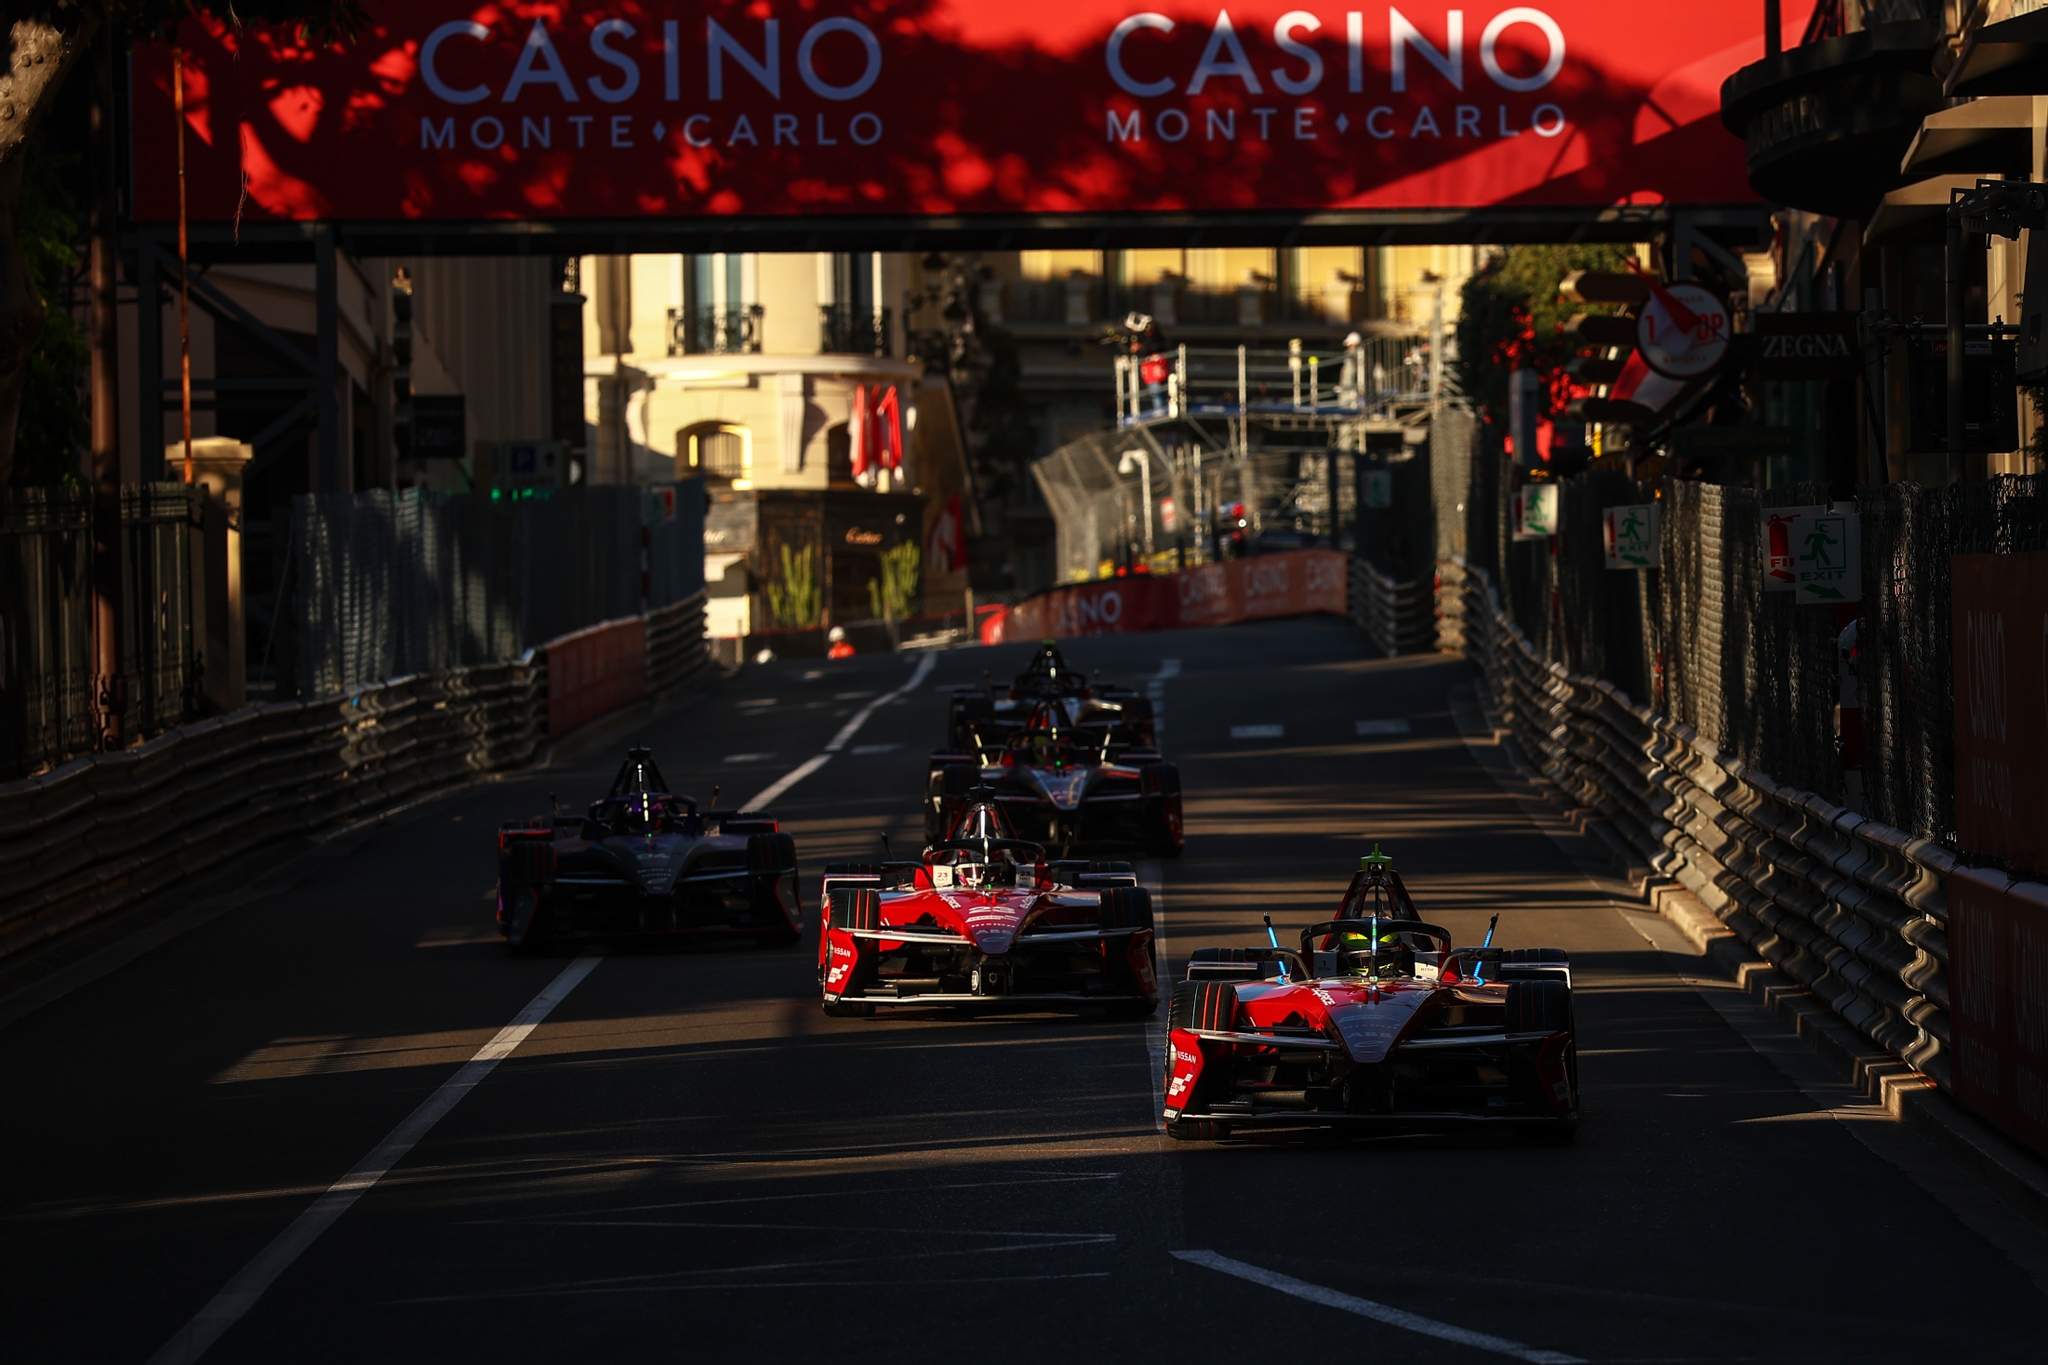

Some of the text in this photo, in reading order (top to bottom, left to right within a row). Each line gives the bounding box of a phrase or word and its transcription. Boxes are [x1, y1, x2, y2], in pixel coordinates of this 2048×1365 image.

[419, 17, 883, 105] CASINO
[1105, 7, 1566, 98] CASINO
[420, 112, 883, 149] MONTE CARLO
[1106, 103, 1566, 142] MONTE CARLO
[1760, 333, 1851, 358] ZEGNA
[1619, 544, 1651, 553] EXIT
[1800, 570, 1846, 582] EXIT
[1967, 609, 2007, 744] CASINO
